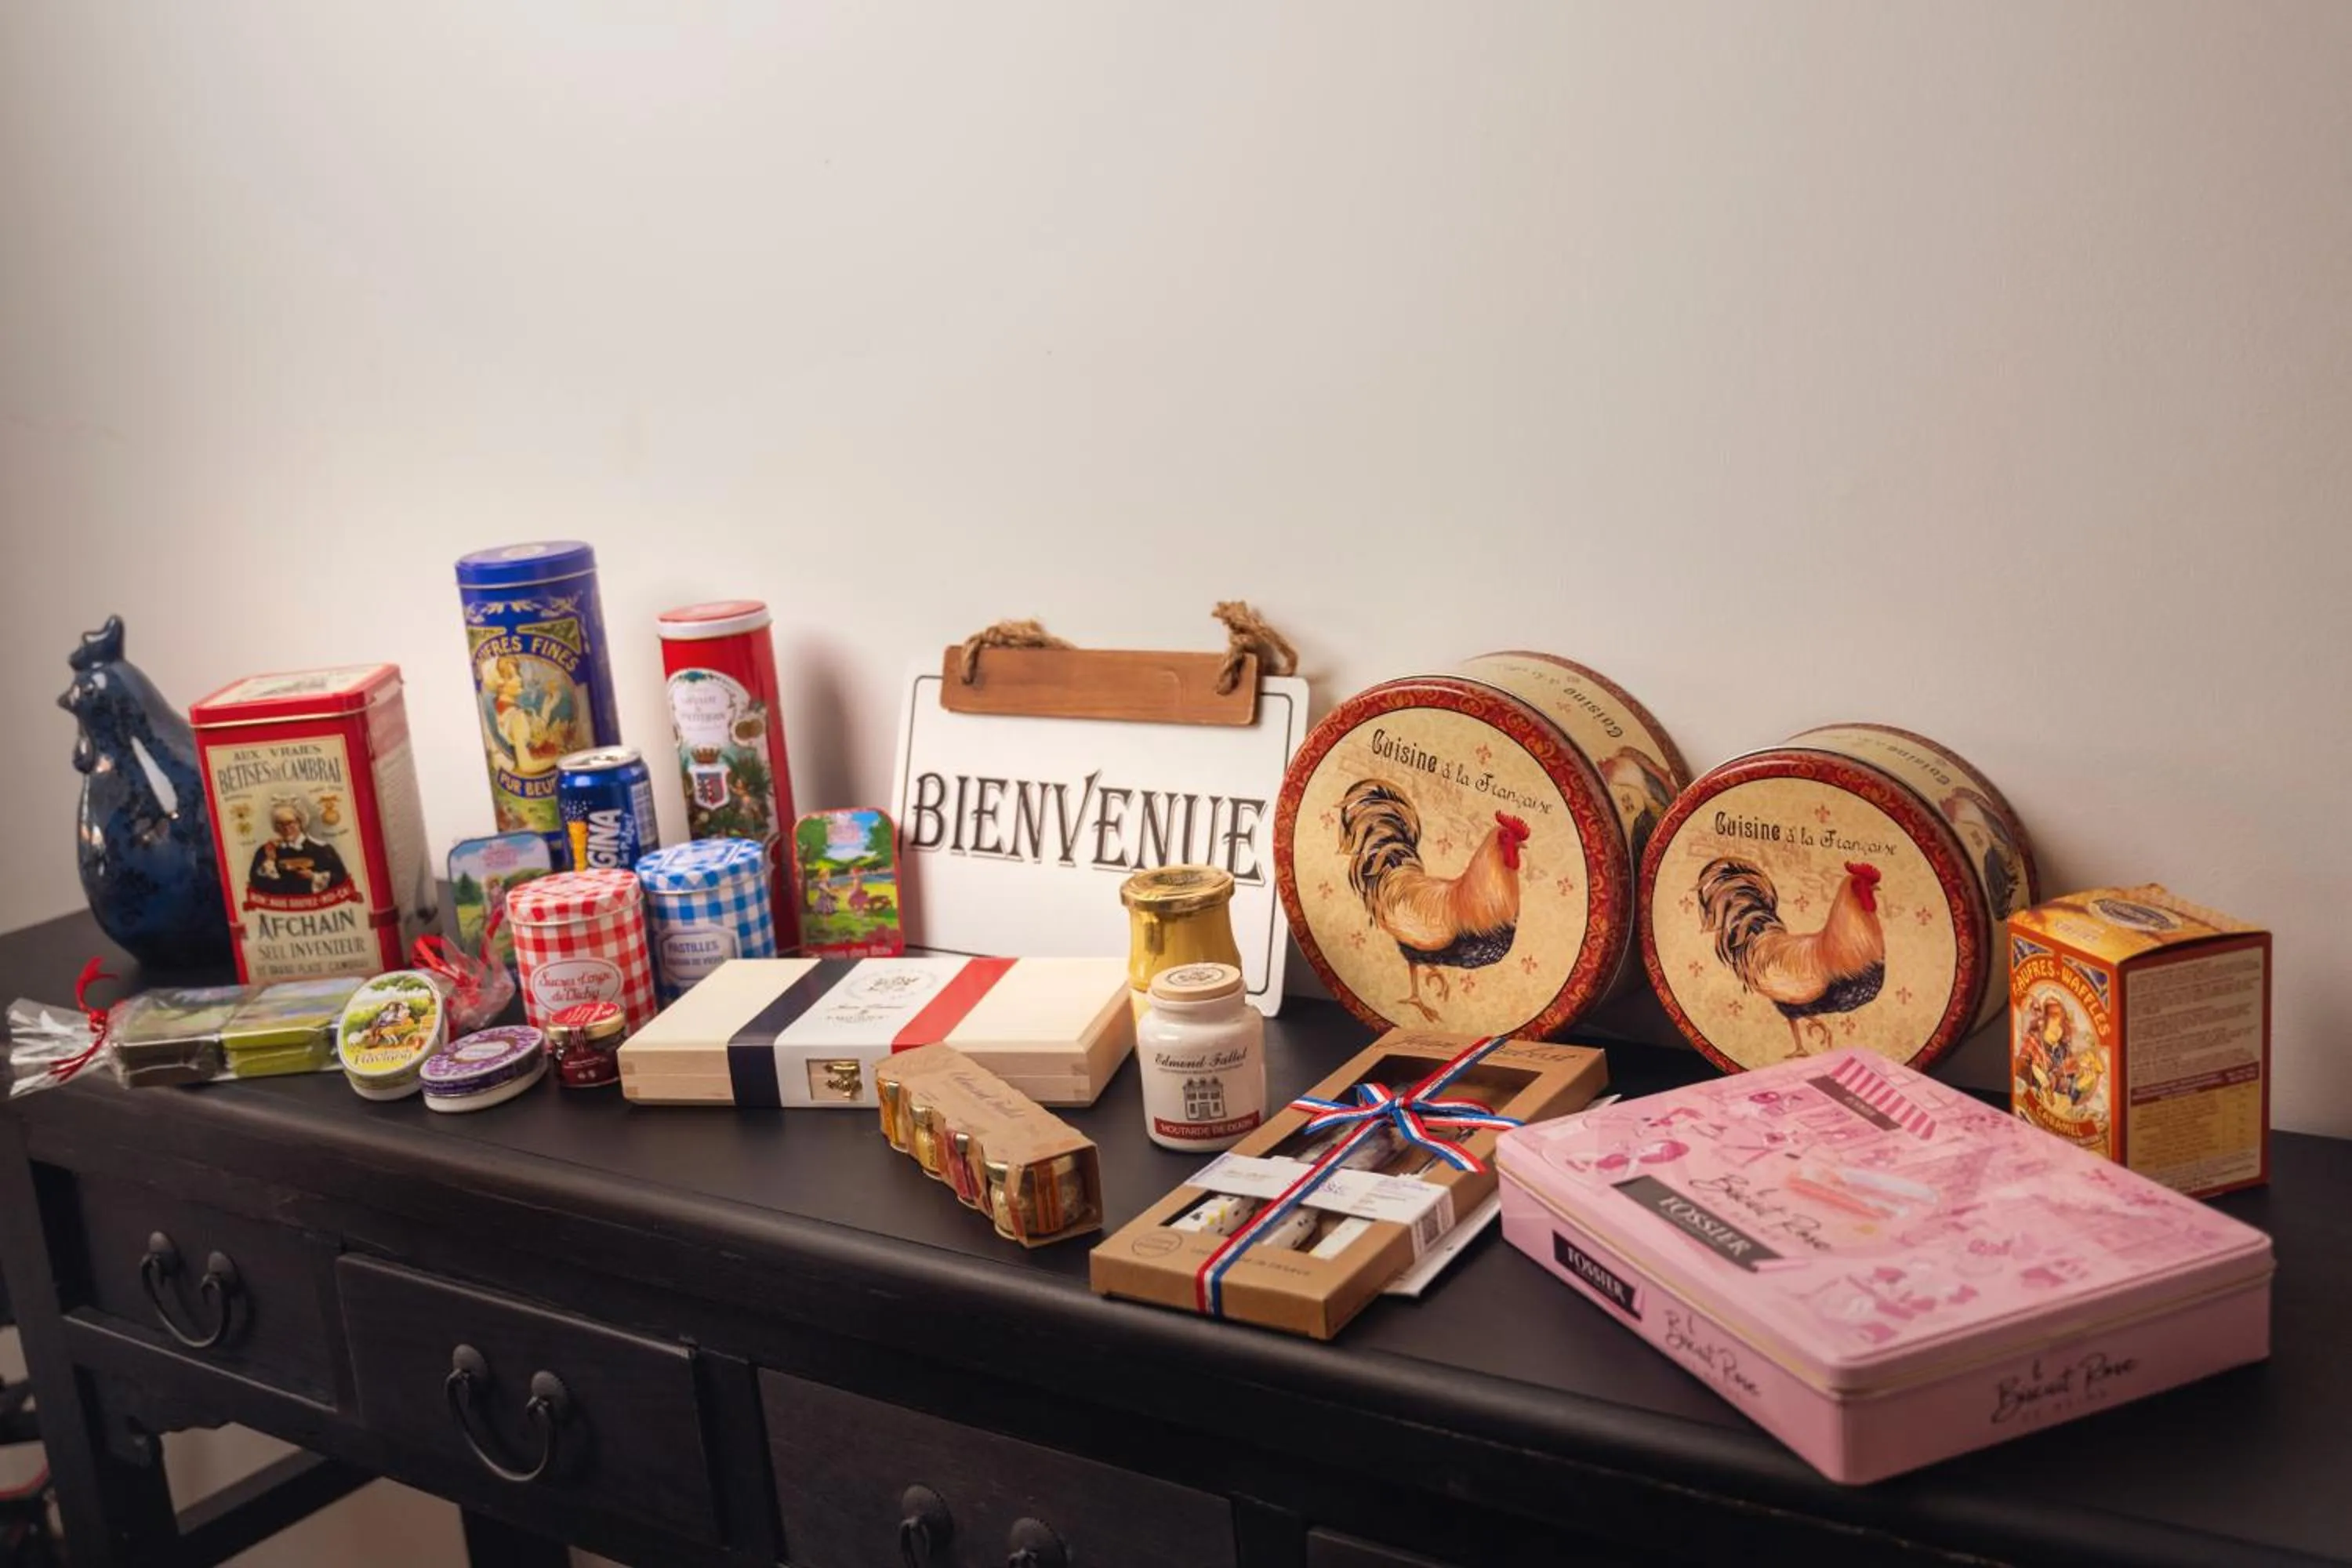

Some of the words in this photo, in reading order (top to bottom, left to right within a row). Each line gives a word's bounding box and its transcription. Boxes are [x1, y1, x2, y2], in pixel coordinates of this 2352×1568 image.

[531, 637, 581, 673] FINES
[281, 757, 343, 786] CAMBRAI
[1371, 728, 1439, 774] Cuisine
[1455, 763, 1471, 787] la
[1474, 771, 1553, 815] Française
[586, 808, 622, 869] GINA
[910, 768, 1267, 884] BIENVENUE
[1715, 810, 1781, 842] Cuisine
[1800, 826, 1814, 847] la
[1820, 829, 1898, 857] Française
[259, 909, 357, 940] AFCHAIN
[290, 937, 366, 960] INVENTEUR
[2061, 965, 2111, 1037] WAFFLES
[1154, 1052, 1205, 1069] Edmond
[1657, 1192, 1752, 1258] FOSSIER
[1566, 1246, 1628, 1304] FOSSIER
